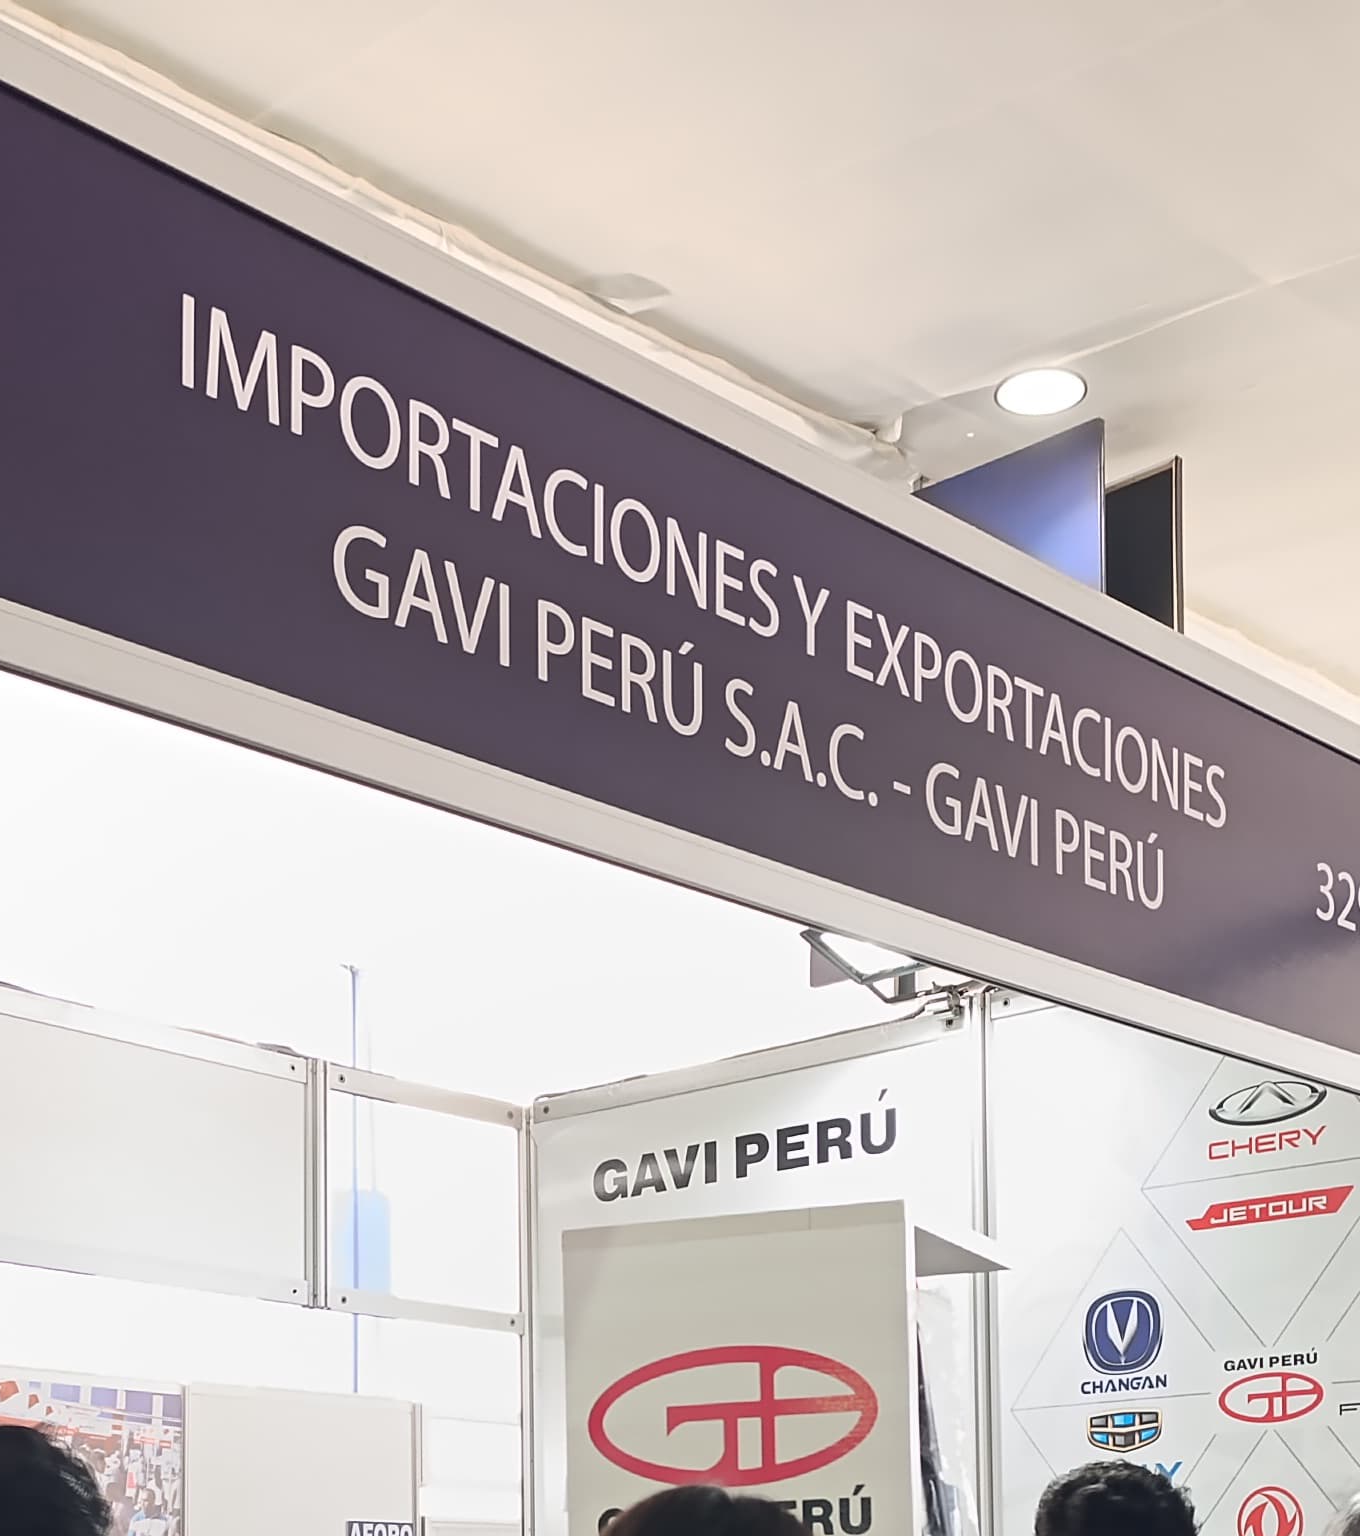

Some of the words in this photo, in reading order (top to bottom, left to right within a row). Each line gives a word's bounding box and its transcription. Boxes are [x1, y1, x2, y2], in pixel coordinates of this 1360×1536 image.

[181, 293, 780, 638] IMPORTACIONES
[793, 575, 831, 657] Y
[844, 599, 1228, 829] EXPORTACIONES
[332, 525, 510, 667] GAVI
[537, 599, 704, 736] PERÚ
[724, 678, 879, 807] S.A.C.
[925, 762, 1039, 866] GAVI
[1053, 807, 1165, 910] PERÚ
[592, 1140, 718, 1202] GAVI
[734, 1088, 897, 1179] PERÚ
[1207, 1125, 1327, 1161] CHERY
[1209, 1194, 1328, 1225] JETOUR
[1223, 1354, 1266, 1371] GAVI
[1269, 1347, 1319, 1368] PERÚ
[1080, 1373, 1168, 1395] CHANGAN
